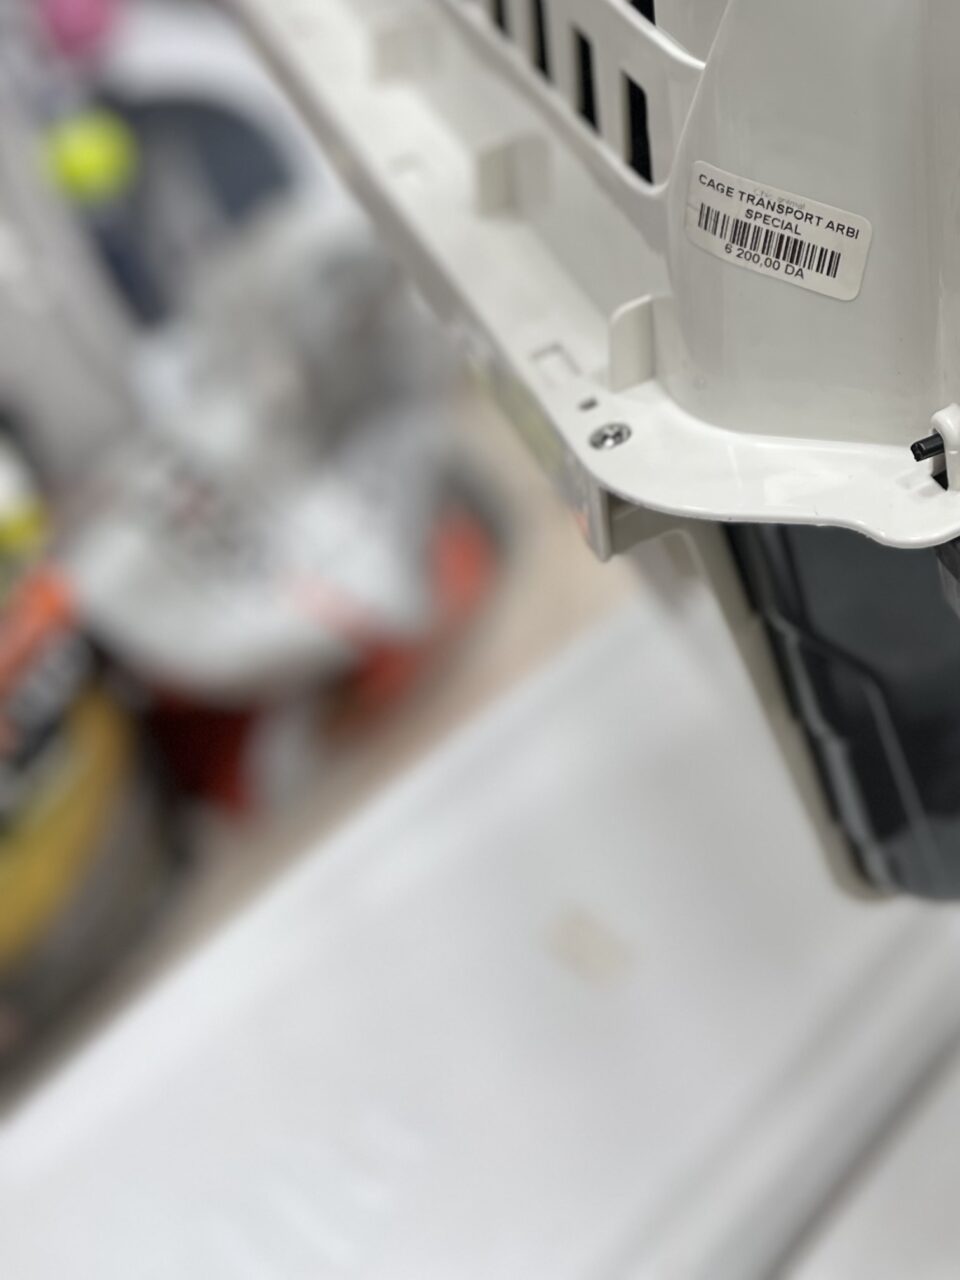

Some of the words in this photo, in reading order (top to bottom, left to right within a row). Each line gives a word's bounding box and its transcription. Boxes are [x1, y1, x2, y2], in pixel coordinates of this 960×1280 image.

[698, 174, 735, 198] CAGE
[738, 190, 823, 227] TRANSPORT
[826, 220, 860, 239] ARBI
[745, 208, 802, 235] SPECIAL
[724, 243, 733, 254] 6
[784, 264, 805, 279] DA
